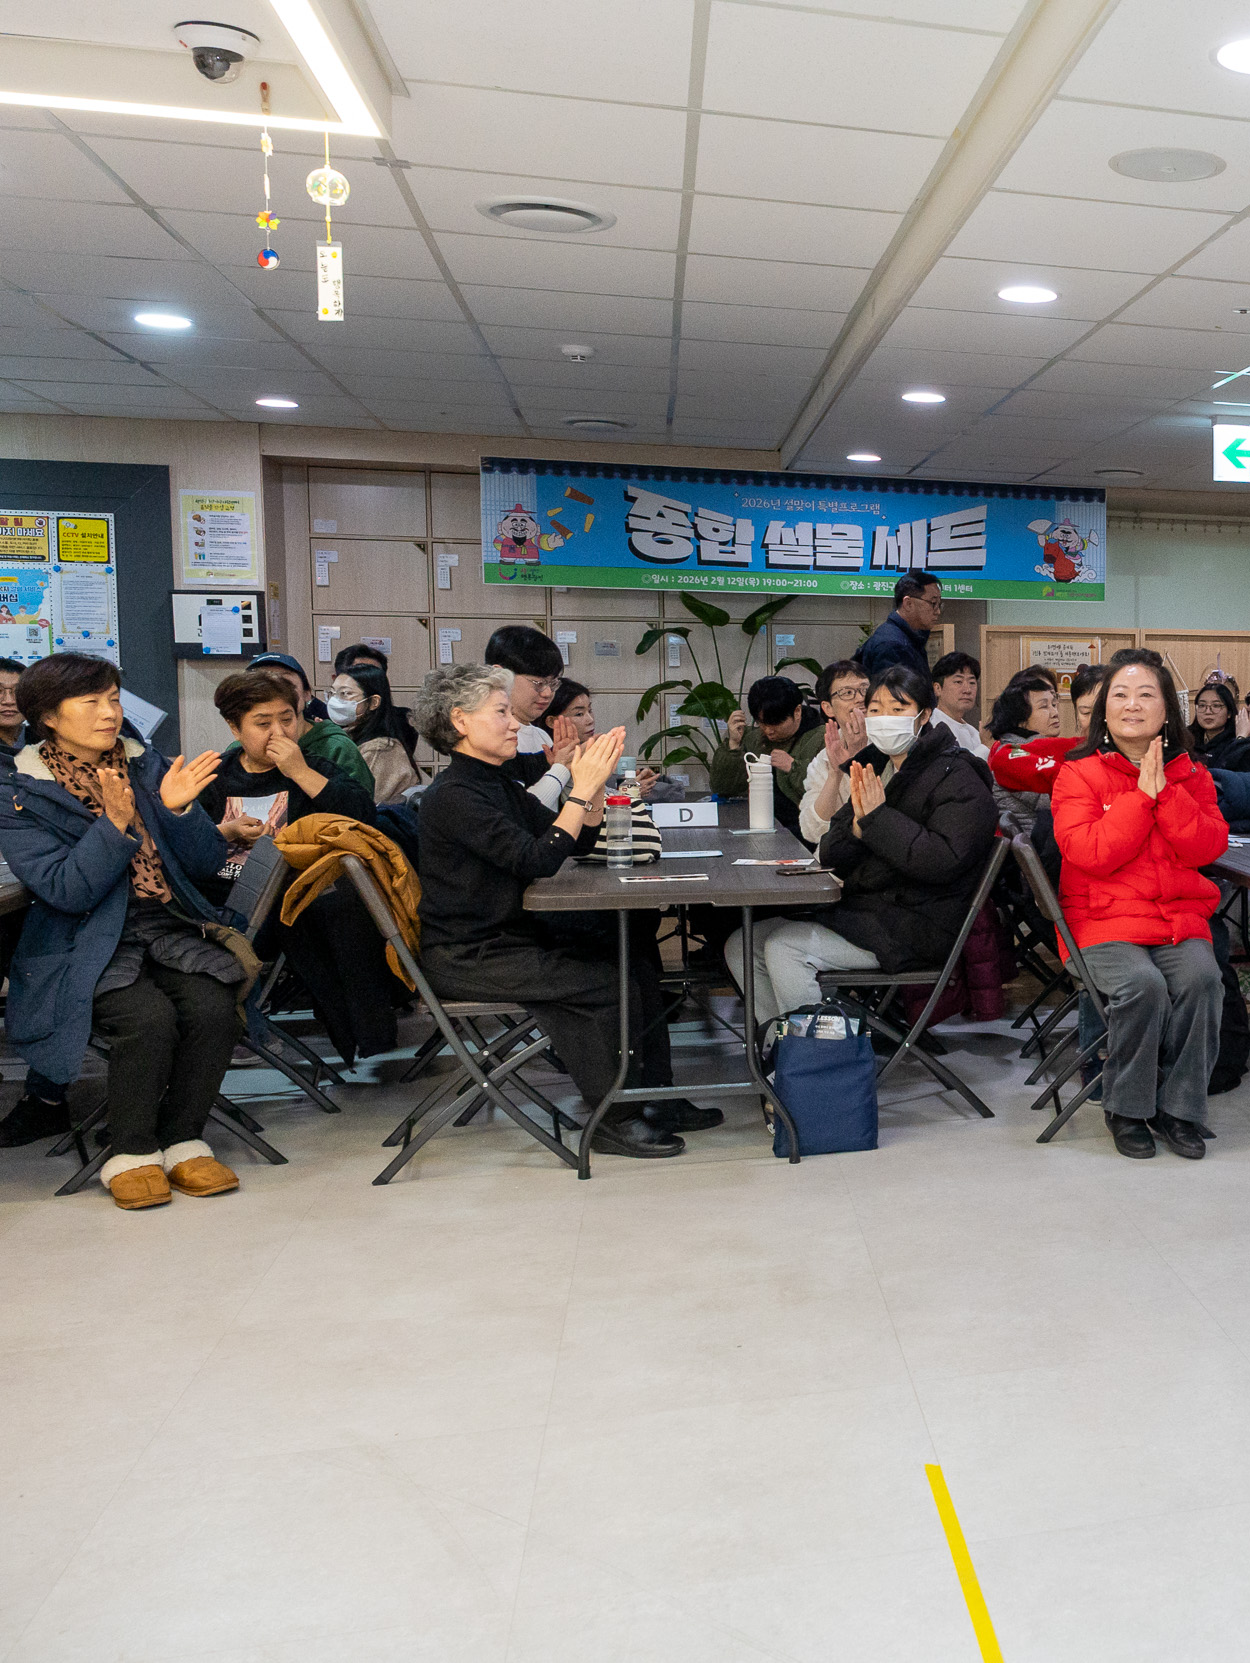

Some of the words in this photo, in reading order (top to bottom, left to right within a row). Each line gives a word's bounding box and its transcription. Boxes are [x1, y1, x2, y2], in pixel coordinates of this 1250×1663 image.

[741, 497, 781, 511] 2026년
[784, 498, 815, 512] 설맞이
[818, 500, 881, 515] 특별프로그램
[17, 528, 45, 537] 마세요
[626, 485, 755, 564] 종합
[872, 504, 988, 568] 세트
[651, 575, 669, 583] 일시
[677, 575, 709, 585] 2026년
[711, 576, 725, 586] 2월
[727, 577, 760, 588] 12일(목)
[762, 578, 818, 588] 19:00~21:00
[849, 580, 865, 591] 장소
[679, 808, 694, 823] D
